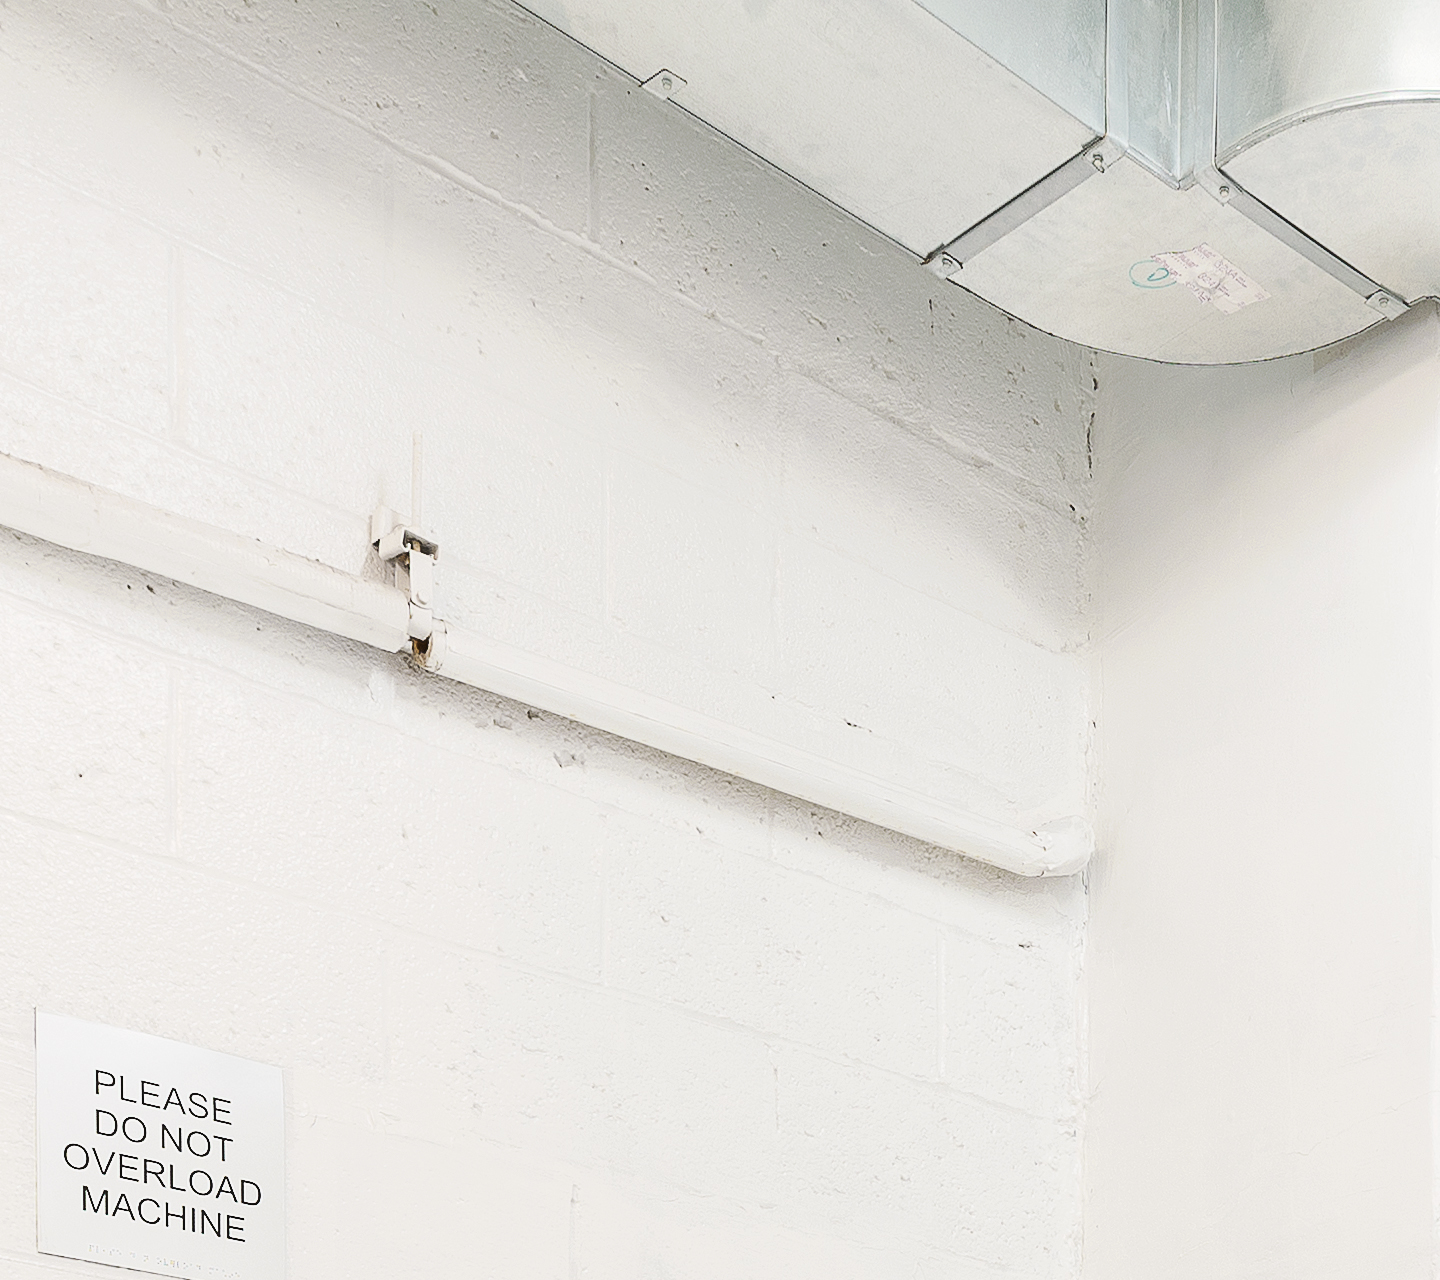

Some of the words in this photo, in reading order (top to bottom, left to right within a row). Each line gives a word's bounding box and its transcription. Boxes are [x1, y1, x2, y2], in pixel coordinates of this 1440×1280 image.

[96, 1070, 232, 1125] PLEASE
[96, 1109, 147, 1143] DO
[161, 1123, 233, 1162] NOT
[64, 1143, 261, 1206] OVERLOAD
[83, 1185, 245, 1242] MACHINE
